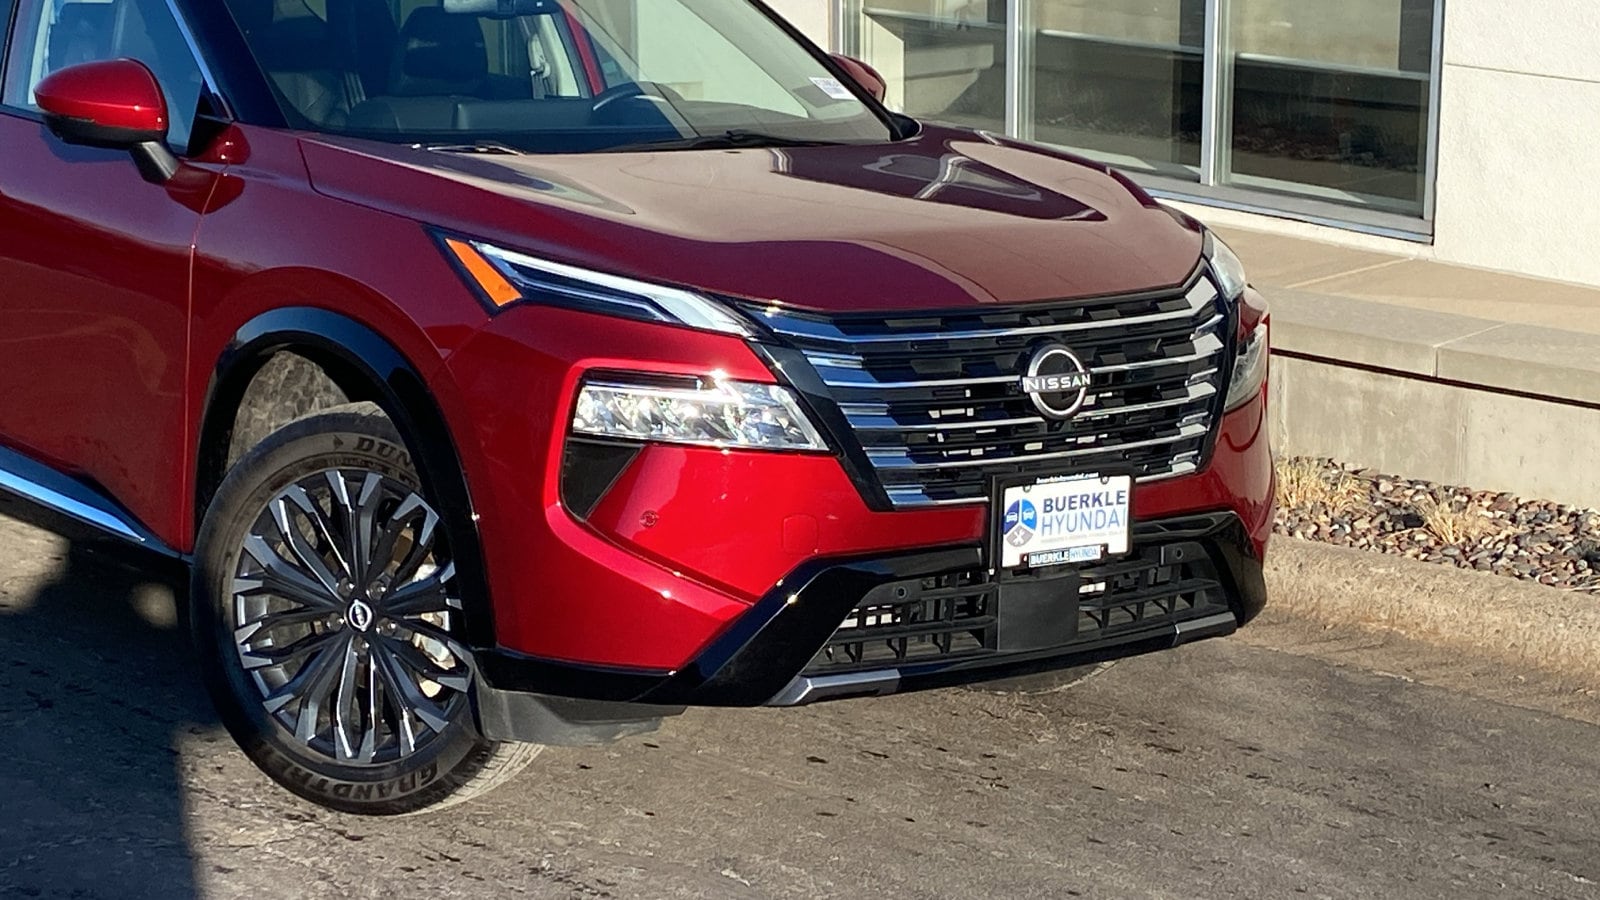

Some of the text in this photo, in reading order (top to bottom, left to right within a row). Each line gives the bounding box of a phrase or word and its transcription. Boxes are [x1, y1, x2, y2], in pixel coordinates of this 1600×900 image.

[1023, 373, 1091, 392] NISSAN
[353, 436, 410, 467] DUN
[1043, 489, 1127, 513] BUERKLE
[1041, 507, 1126, 536] HYUNDAI
[1031, 551, 1069, 565] BUERKLE
